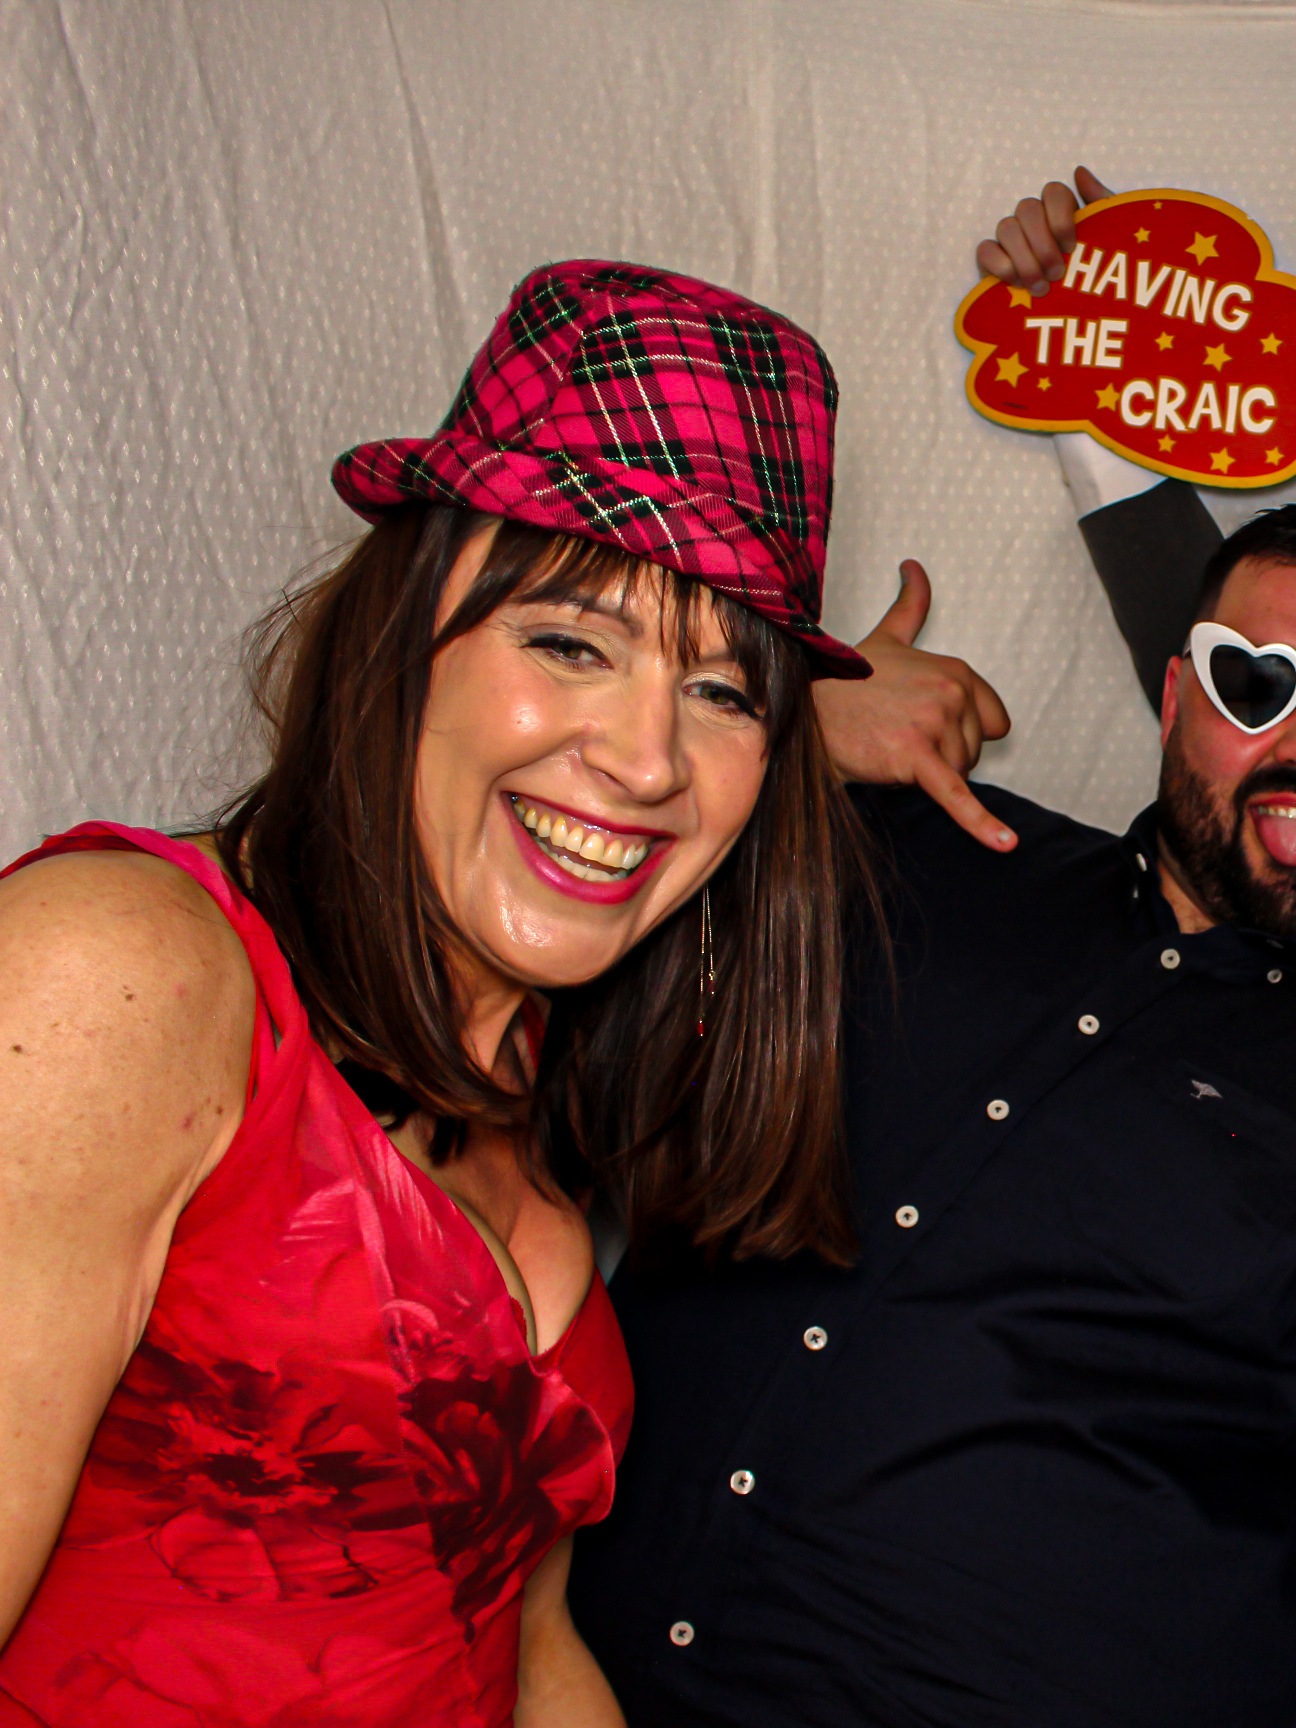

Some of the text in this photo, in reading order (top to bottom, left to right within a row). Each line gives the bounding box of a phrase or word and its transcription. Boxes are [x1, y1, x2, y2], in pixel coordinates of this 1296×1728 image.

[1063, 243, 1253, 331] HAVING
[1025, 317, 1128, 368] THE
[1120, 378, 1276, 434] CRAIC
